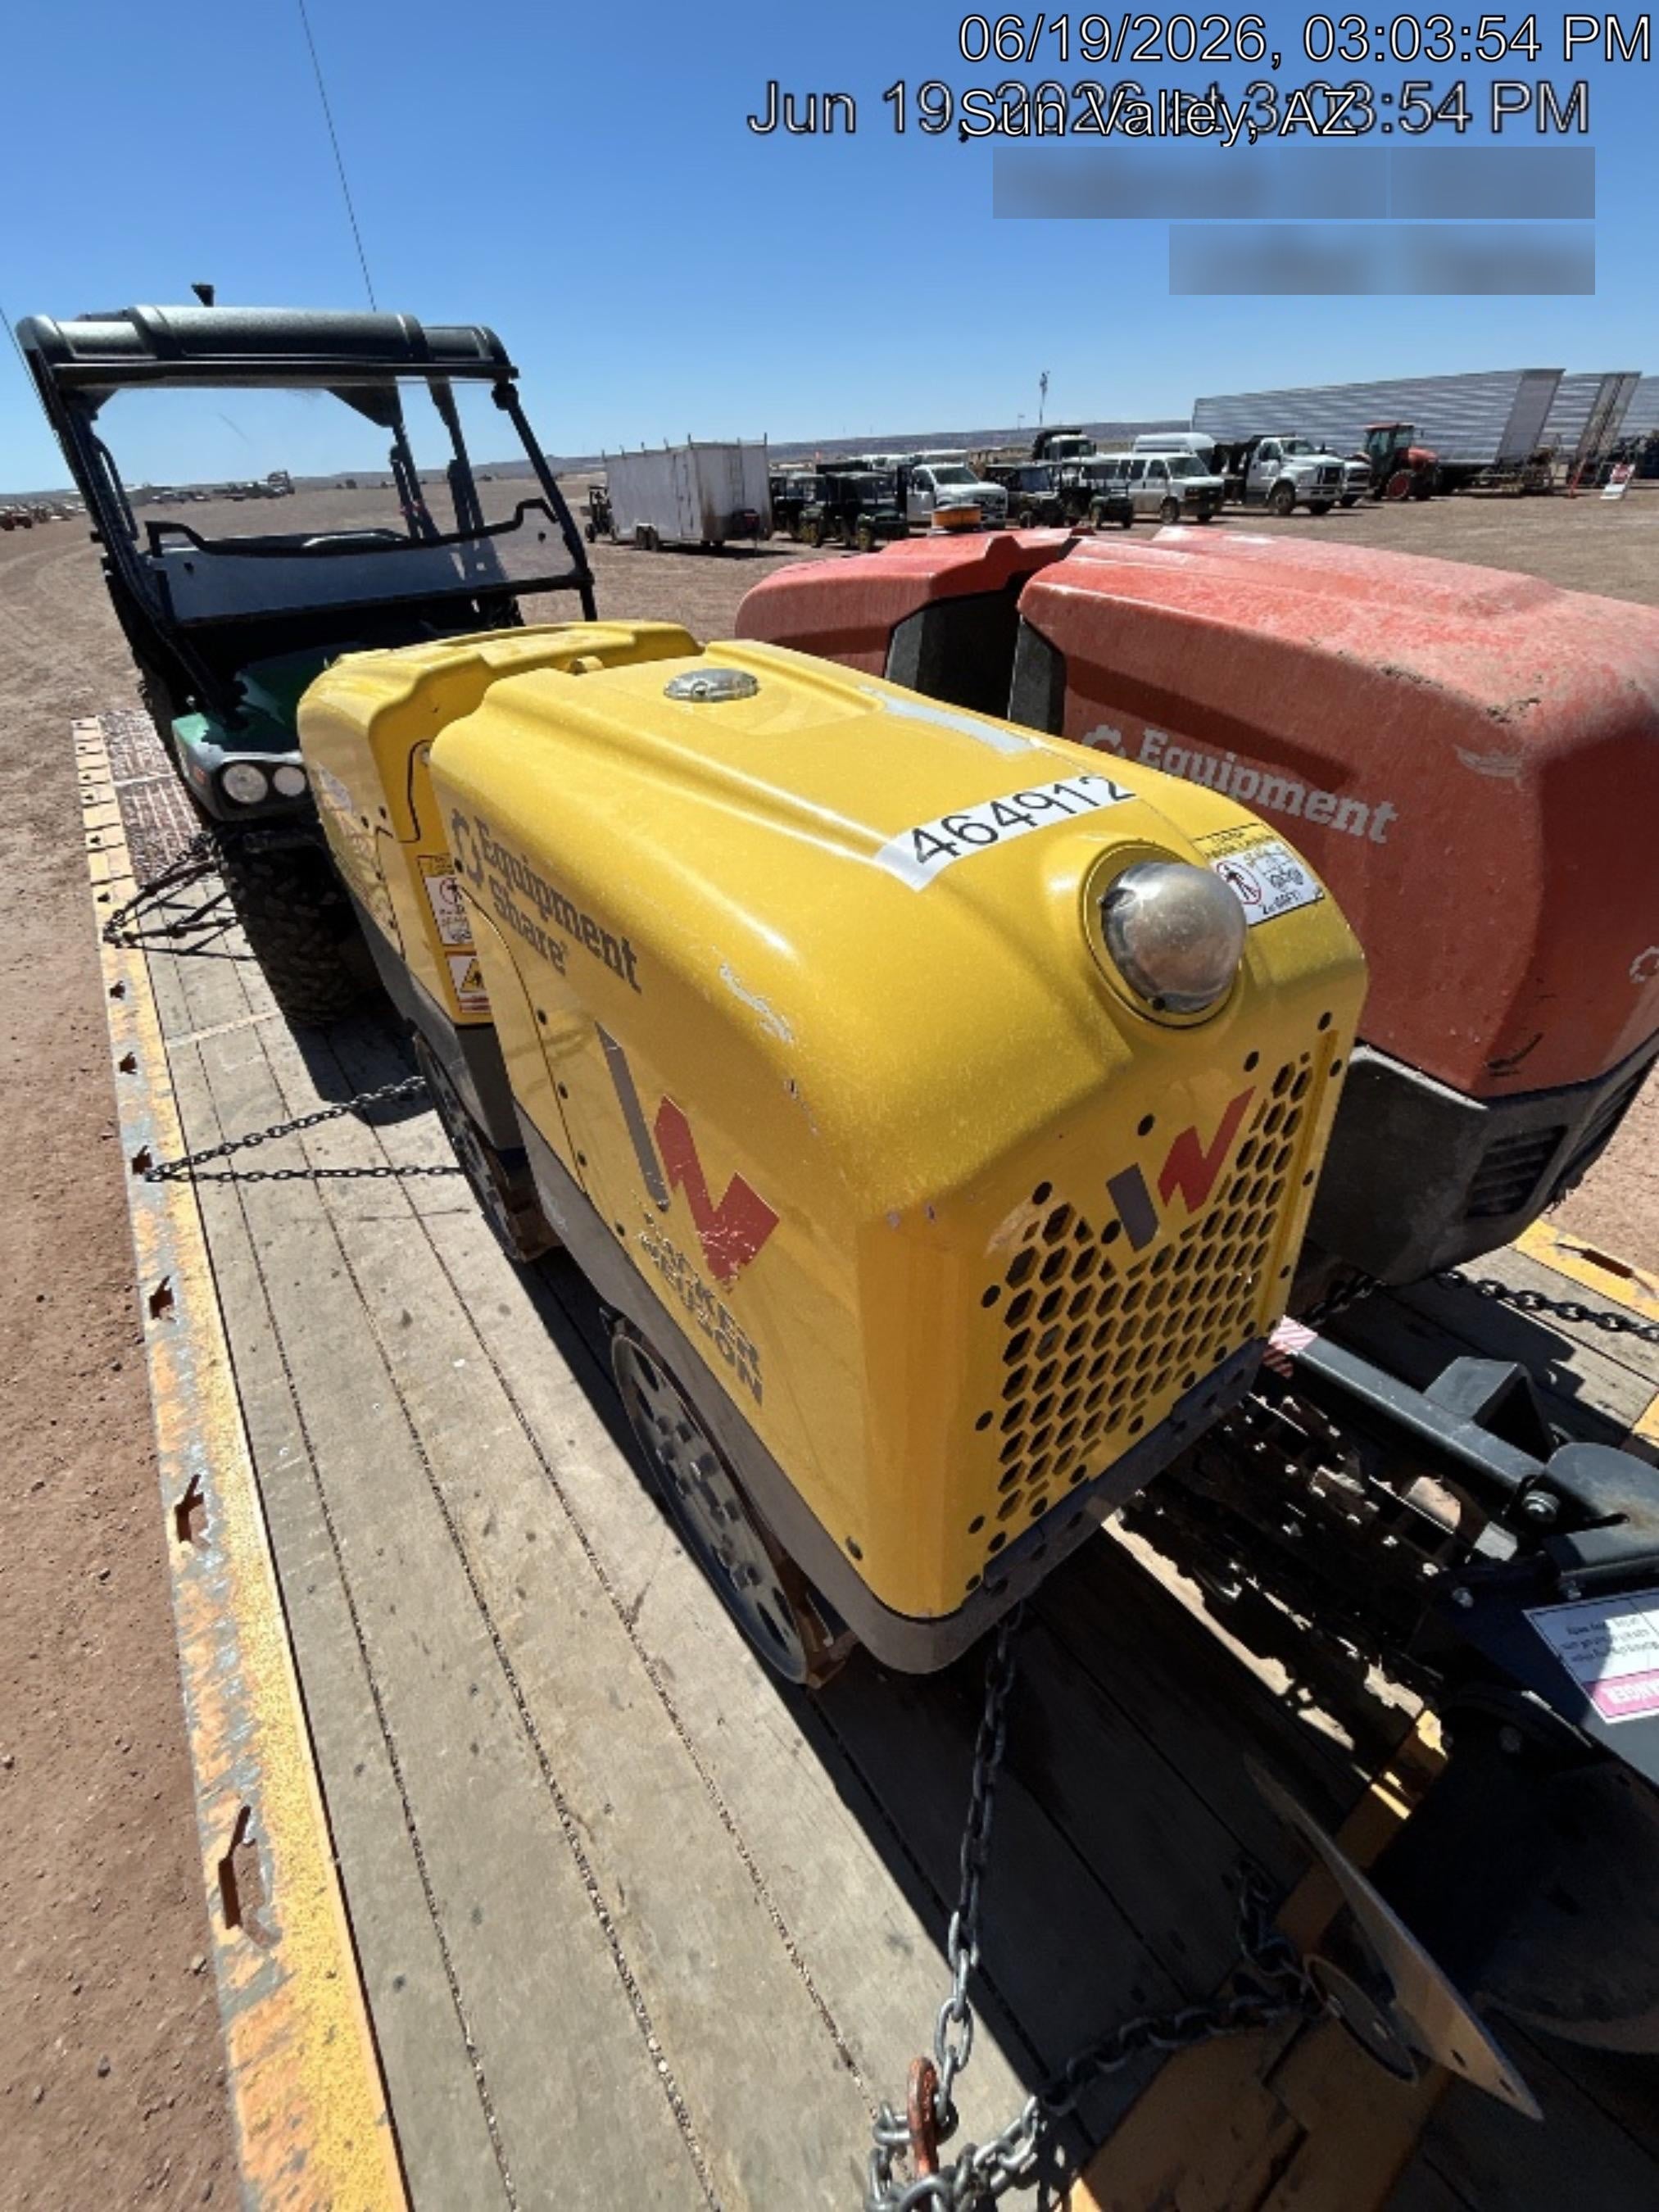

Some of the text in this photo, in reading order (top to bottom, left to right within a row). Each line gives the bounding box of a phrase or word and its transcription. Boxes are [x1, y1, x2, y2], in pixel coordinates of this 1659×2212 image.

[911, 775, 1137, 864] 464912
[1136, 728, 1398, 845] Equipment
[473, 814, 642, 995] Equipment
[487, 873, 567, 977] Share
